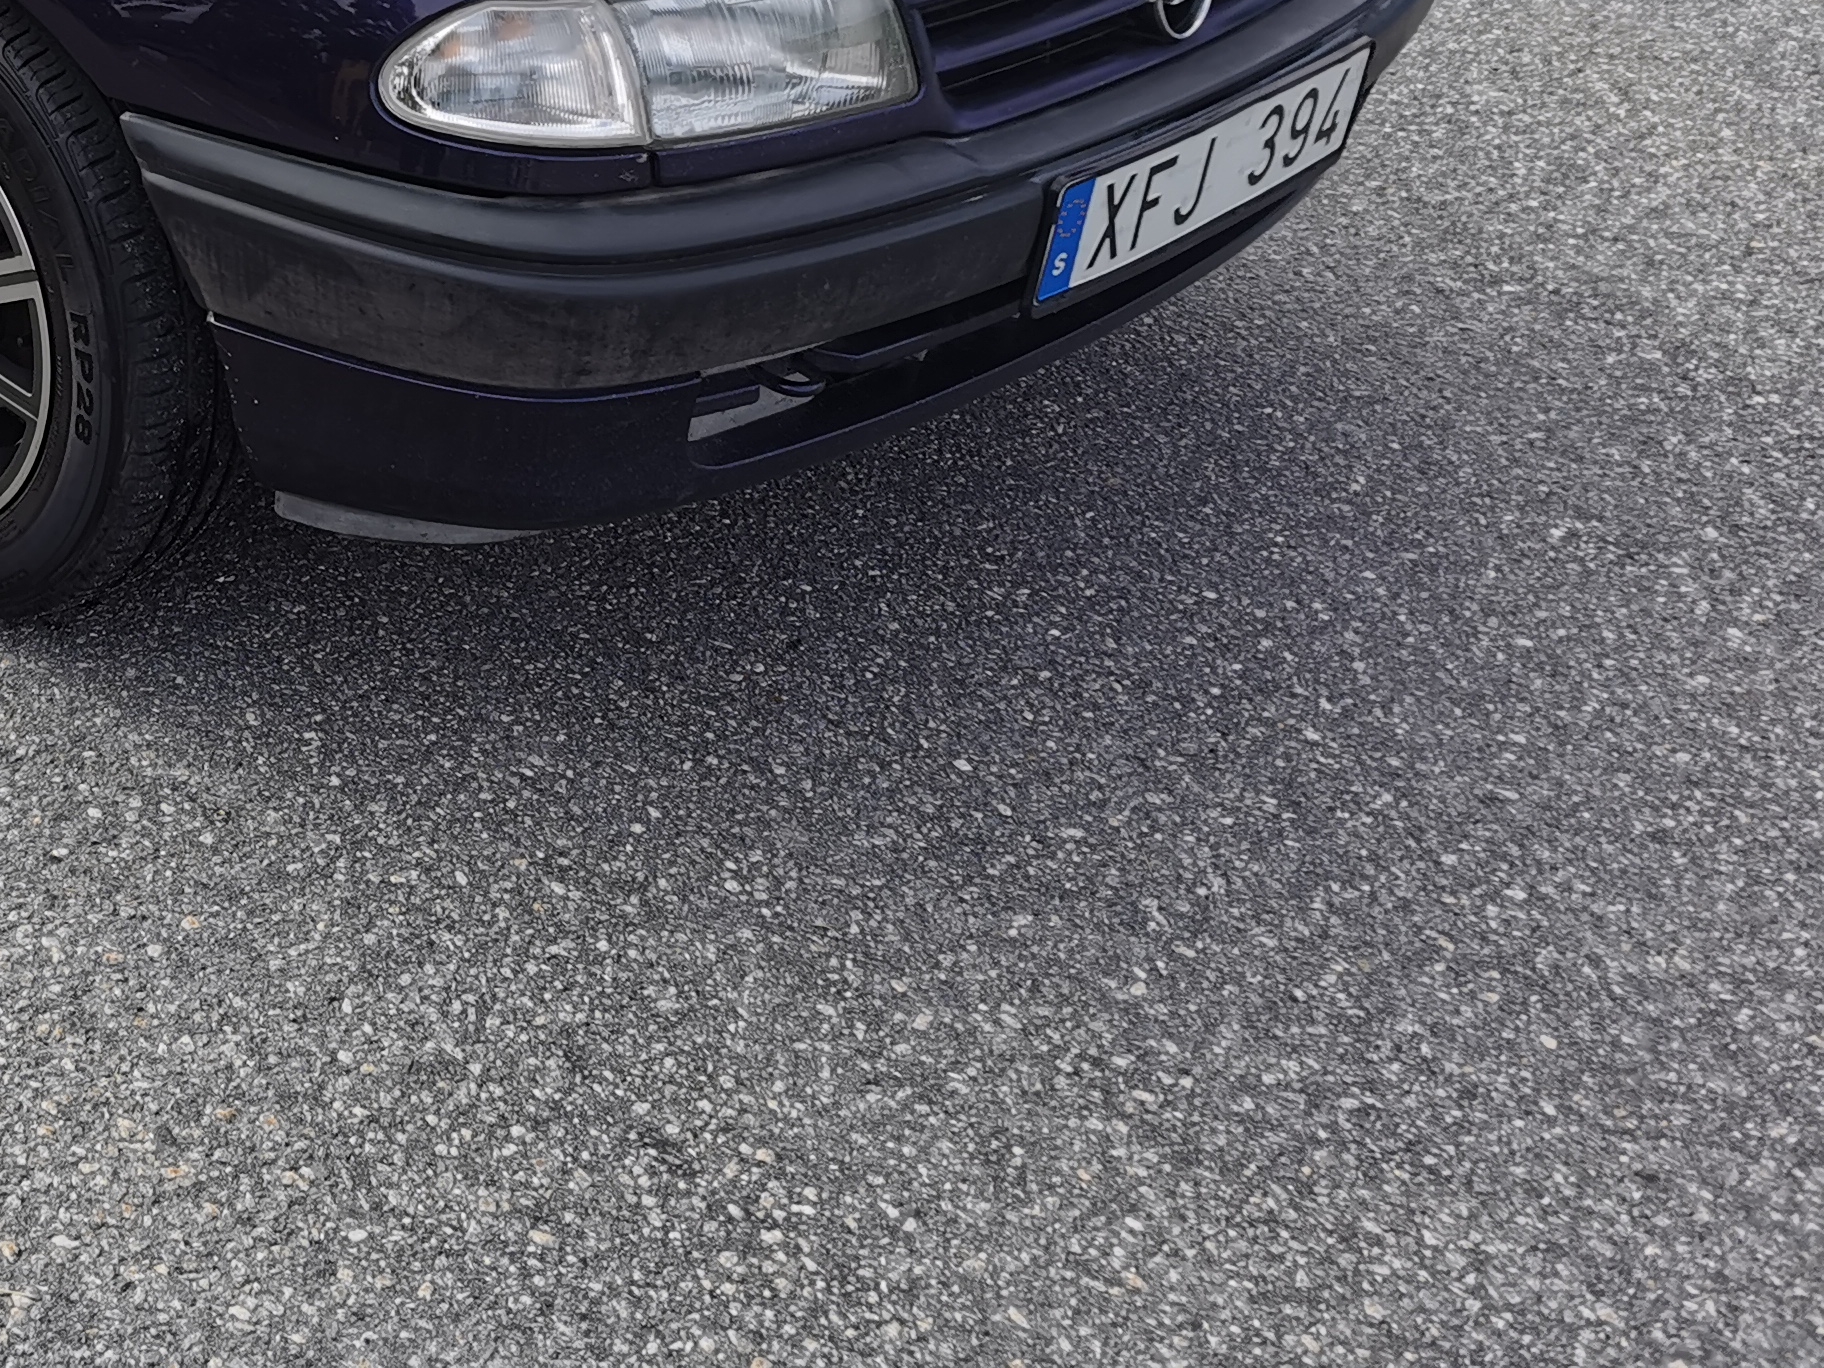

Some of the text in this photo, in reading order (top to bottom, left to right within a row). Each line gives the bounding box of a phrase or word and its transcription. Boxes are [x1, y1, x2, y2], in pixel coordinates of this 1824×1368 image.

[1087, 67, 1351, 270] XFJ 394
[1052, 253, 1068, 277] S
[69, 312, 96, 446] RP28
